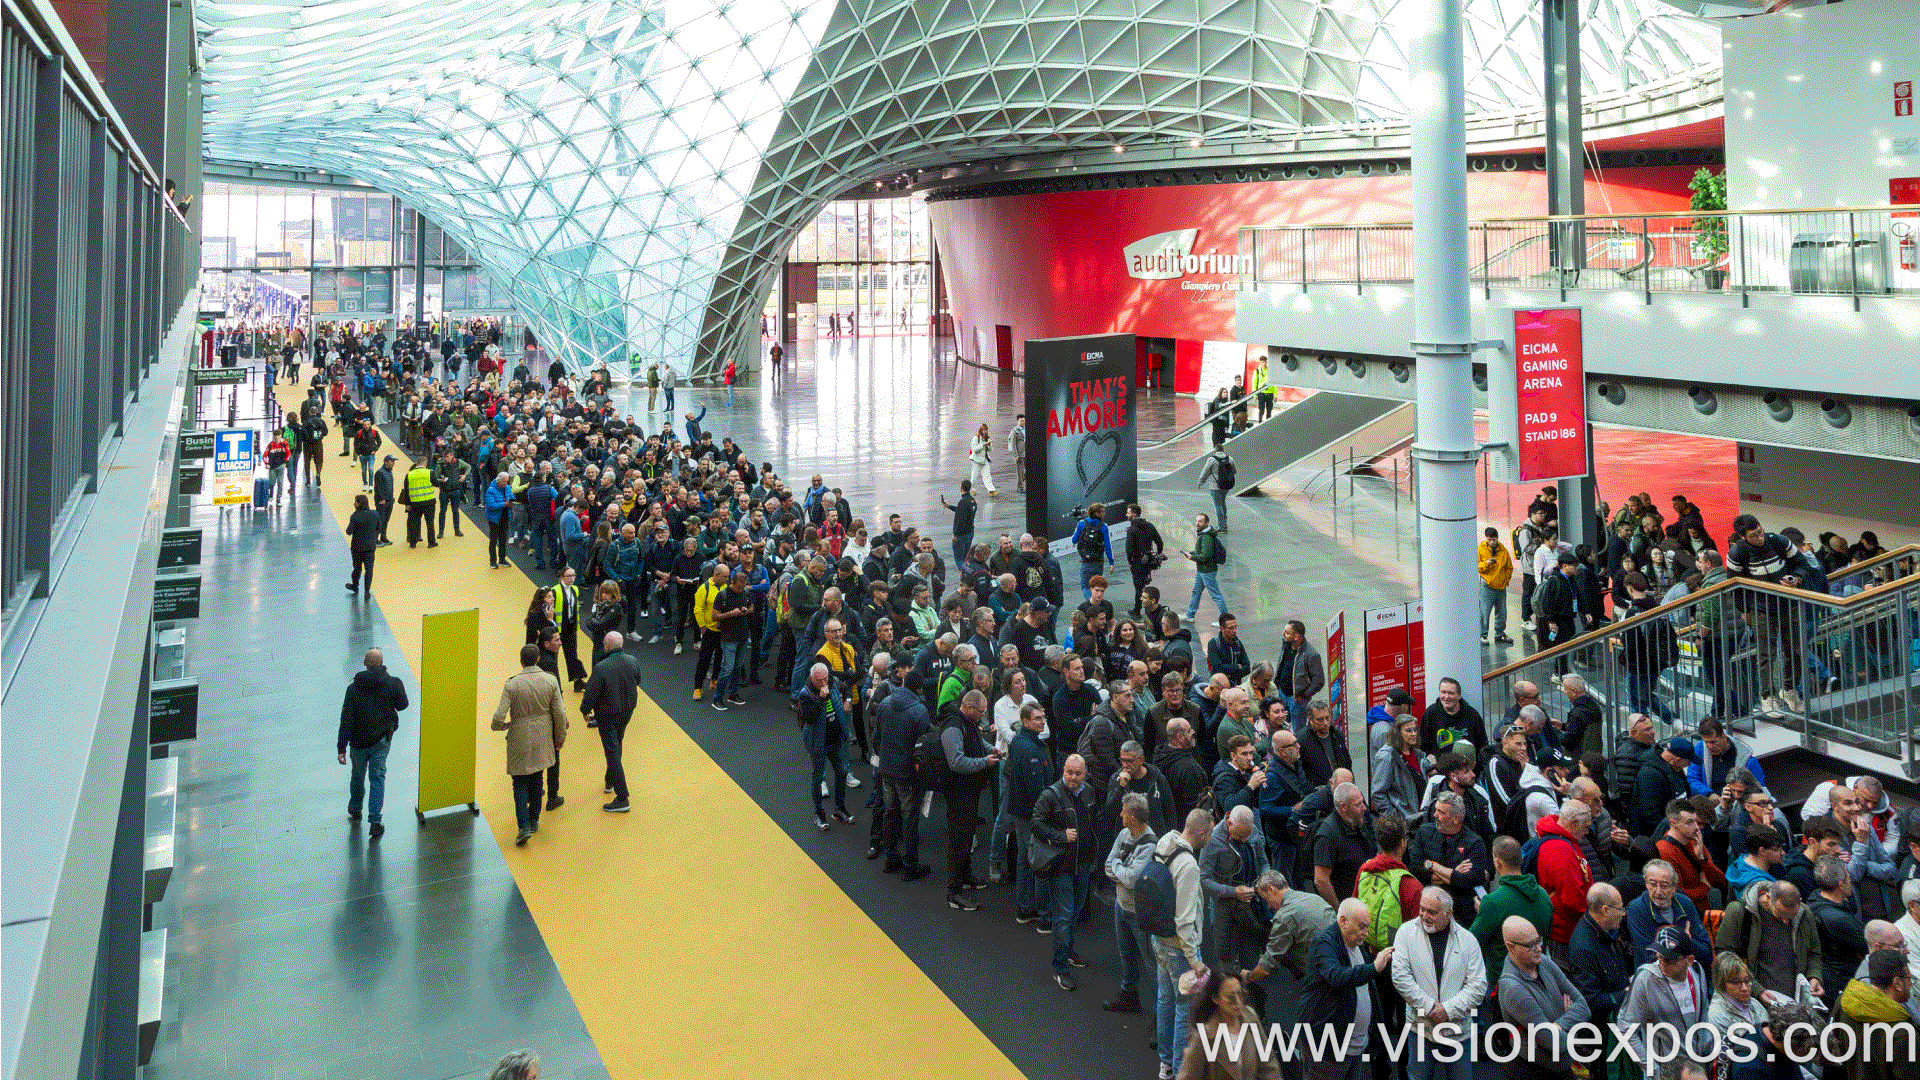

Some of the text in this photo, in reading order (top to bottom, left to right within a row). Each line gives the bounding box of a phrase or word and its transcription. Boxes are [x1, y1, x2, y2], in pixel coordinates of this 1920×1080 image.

[1133, 248, 1253, 274] auditorium
[1181, 280, 1220, 293] Giampiero
[1522, 343, 1558, 355] EICMA
[1086, 351, 1104, 360] EICMA
[1522, 359, 1568, 372] GAMING
[1069, 375, 1127, 404] THAT'S
[1523, 377, 1562, 390] ARENA
[1046, 398, 1127, 440] AMORE
[1525, 412, 1557, 424] PAD 9
[185, 437, 213, 445] Busin
[1525, 430, 1558, 442] STAND
[222, 433, 246, 460] T
[216, 460, 251, 472] TABACCHI
[932, 657, 951, 669] FILA
